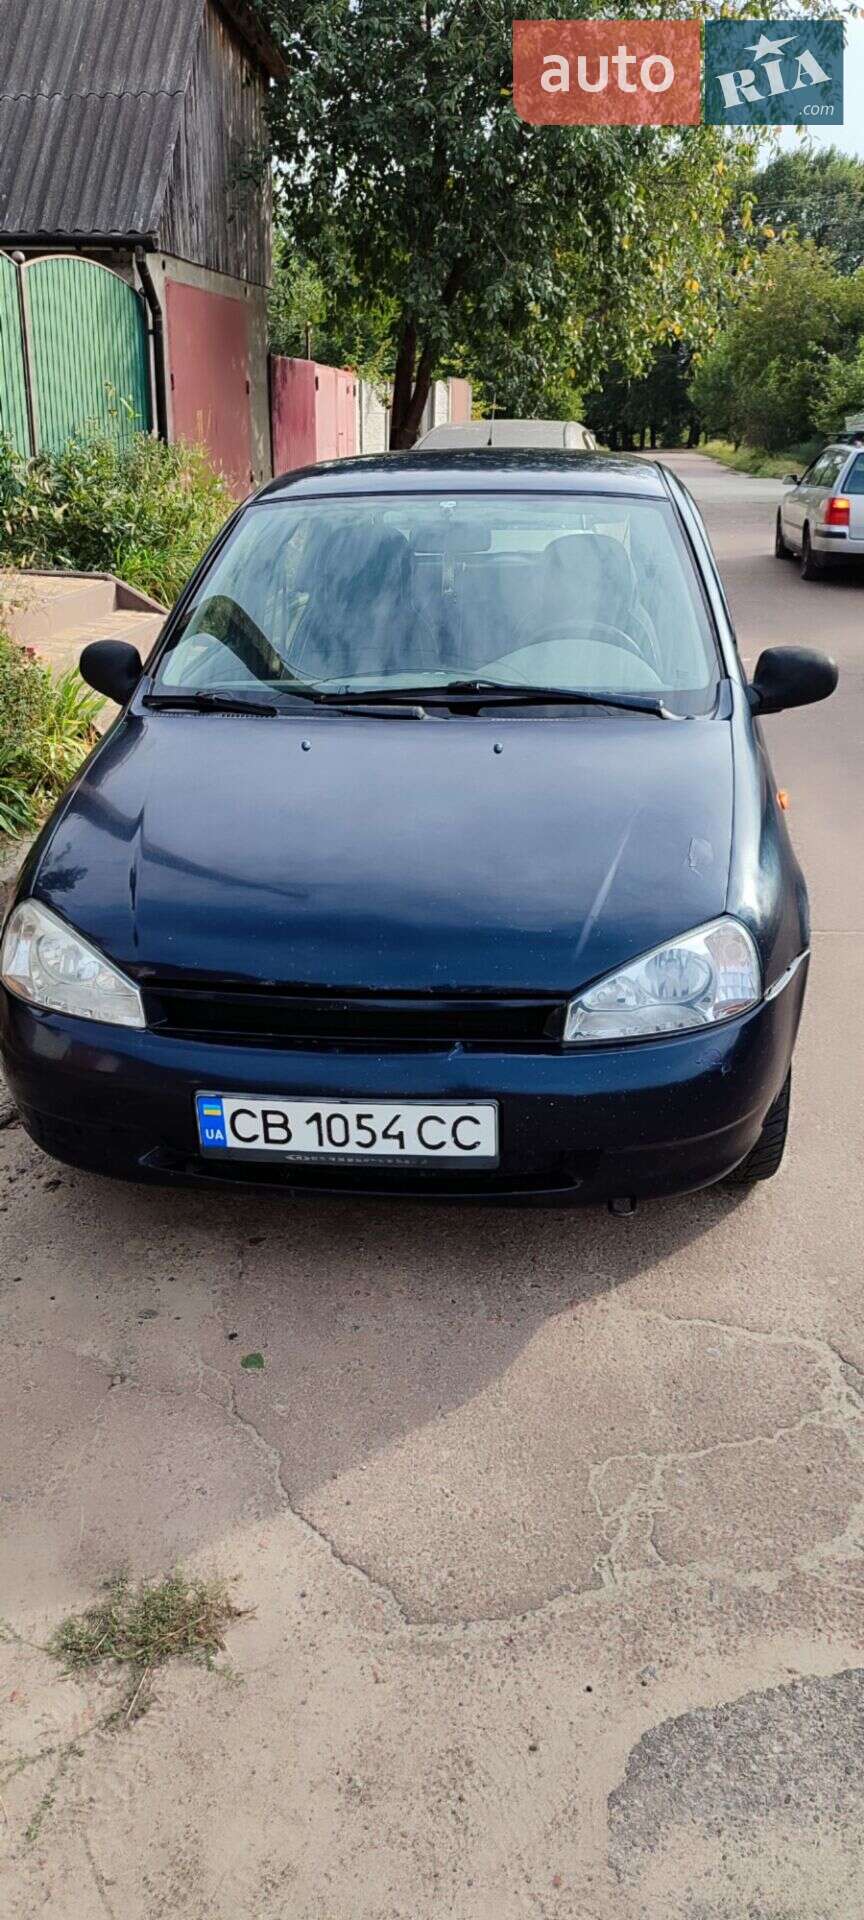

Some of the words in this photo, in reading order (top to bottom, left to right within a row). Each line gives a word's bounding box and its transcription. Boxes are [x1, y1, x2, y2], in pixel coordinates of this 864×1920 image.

[205, 1129, 224, 1140] UA
[229, 1109, 293, 1145] CB
[305, 1112, 405, 1149] 1054
[417, 1115, 481, 1150] CC
